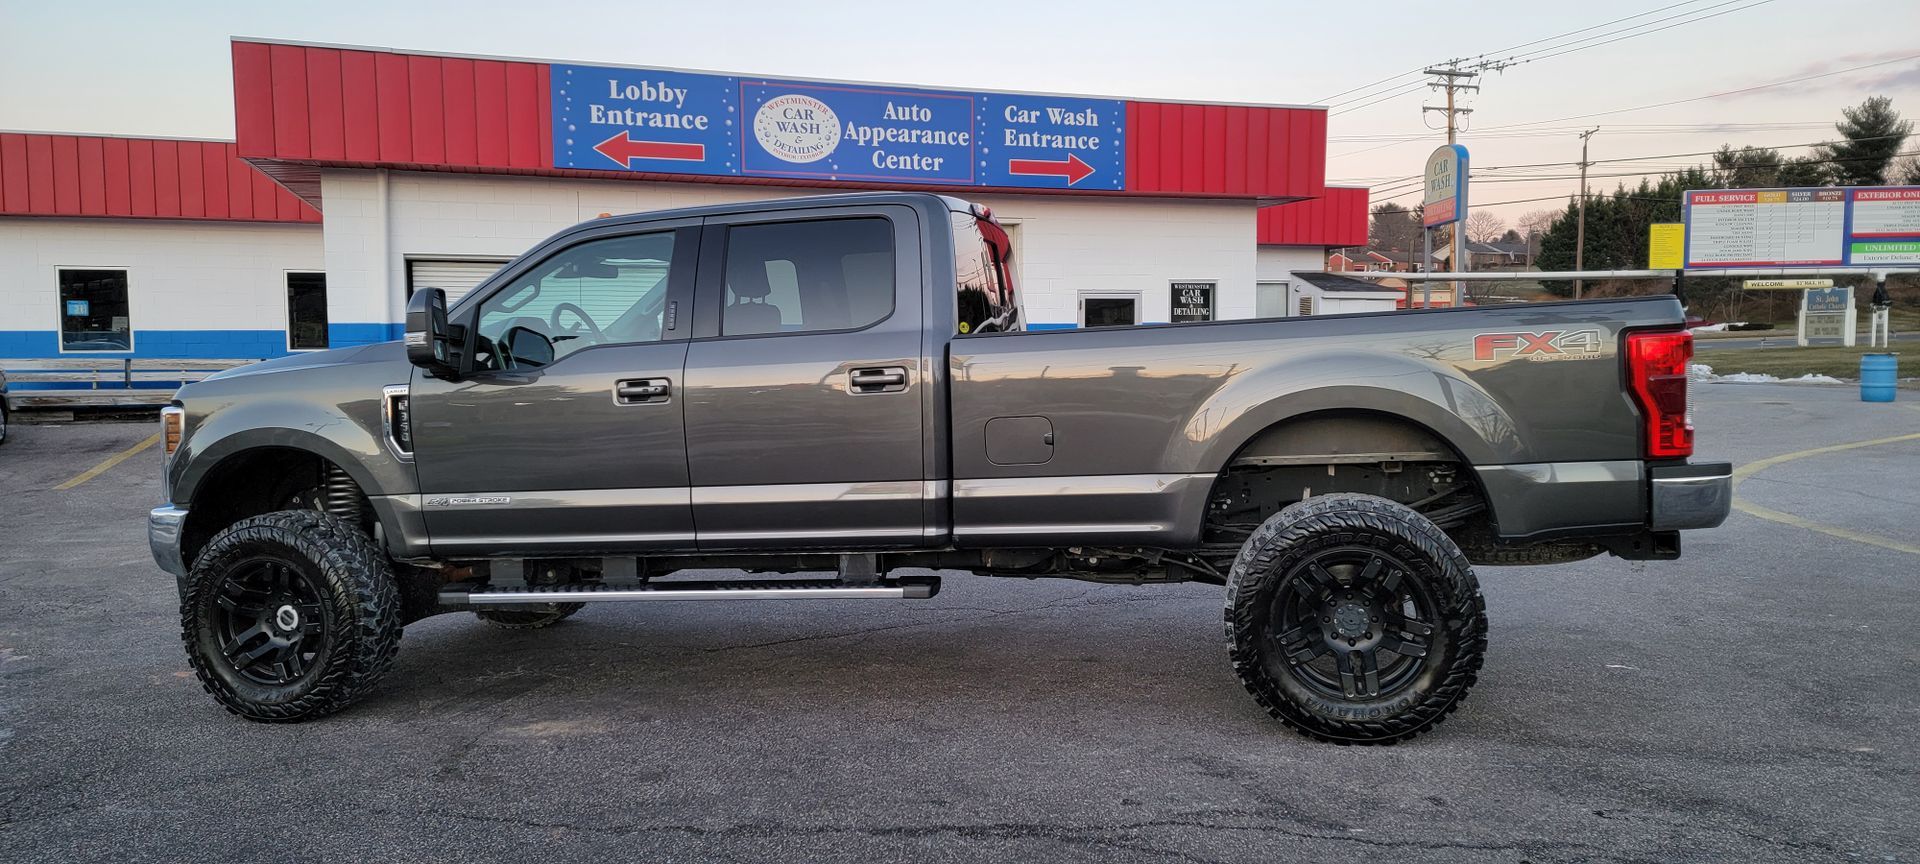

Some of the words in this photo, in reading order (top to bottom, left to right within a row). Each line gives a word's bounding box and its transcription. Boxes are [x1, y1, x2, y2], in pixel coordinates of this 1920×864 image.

[608, 79, 688, 109] Lobby
[767, 97, 829, 115] WESTMINSTER
[783, 107, 815, 120] CAR
[883, 101, 932, 122] Auto
[589, 103, 709, 130] Entrance
[1004, 105, 1040, 124] Car
[1046, 107, 1099, 127] Wash
[776, 121, 820, 134] WASH
[844, 121, 970, 146] Appearance
[773, 139, 824, 154] DETAILING
[795, 135, 803, 144] &
[1004, 128, 1100, 150] Entrance
[872, 150, 944, 171] Center
[1434, 159, 1448, 176] CAR
[1431, 174, 1450, 192] WASH
[1695, 195, 1717, 203] FULL
[1718, 194, 1756, 202] SERVICE
[1857, 191, 1902, 199] EXTERIOR
[1865, 244, 1917, 252] UNLIMITED
[1180, 296, 1204, 304] WASH
[1182, 289, 1201, 297] CAR
[1173, 307, 1210, 316] DETAILING
[1473, 329, 1602, 362] FX4
